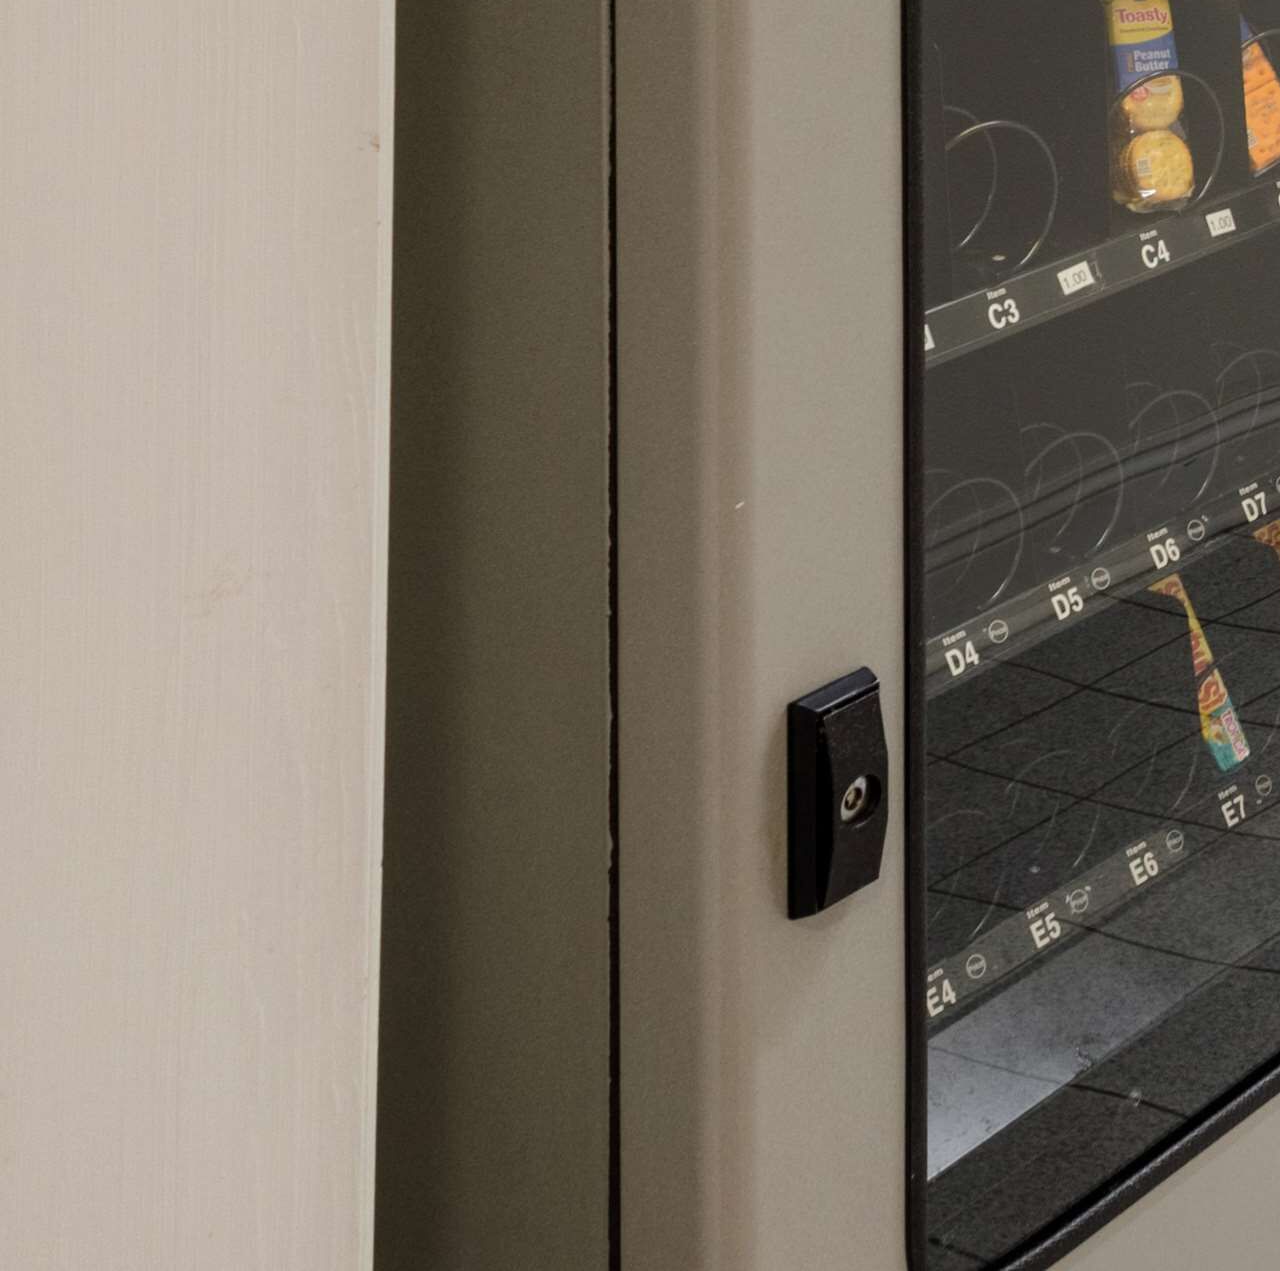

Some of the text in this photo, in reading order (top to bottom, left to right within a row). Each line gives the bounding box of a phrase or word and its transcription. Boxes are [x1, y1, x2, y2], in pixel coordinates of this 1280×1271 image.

[1114, 8, 1169, 25] Toasty
[1133, 49, 1171, 61] Peanut
[1134, 60, 1169, 73] Butter
[1210, 215, 1232, 231] 1.00
[1141, 240, 1170, 269] C4
[1063, 270, 1088, 289] 1.00
[988, 299, 1020, 329] C3
[1241, 492, 1268, 522] D7
[1147, 527, 1168, 542] Item
[1150, 538, 1181, 570] D6
[1048, 576, 1071, 592] Item
[1051, 587, 1084, 621] D5
[943, 630, 967, 646] Item
[945, 641, 980, 677] D4
[1221, 795, 1247, 829] E7
[1125, 841, 1147, 858] Item
[1129, 851, 1159, 886] E6
[1026, 902, 1049, 920] Item
[1029, 912, 1061, 949] E5
[926, 979, 957, 1017] E4
